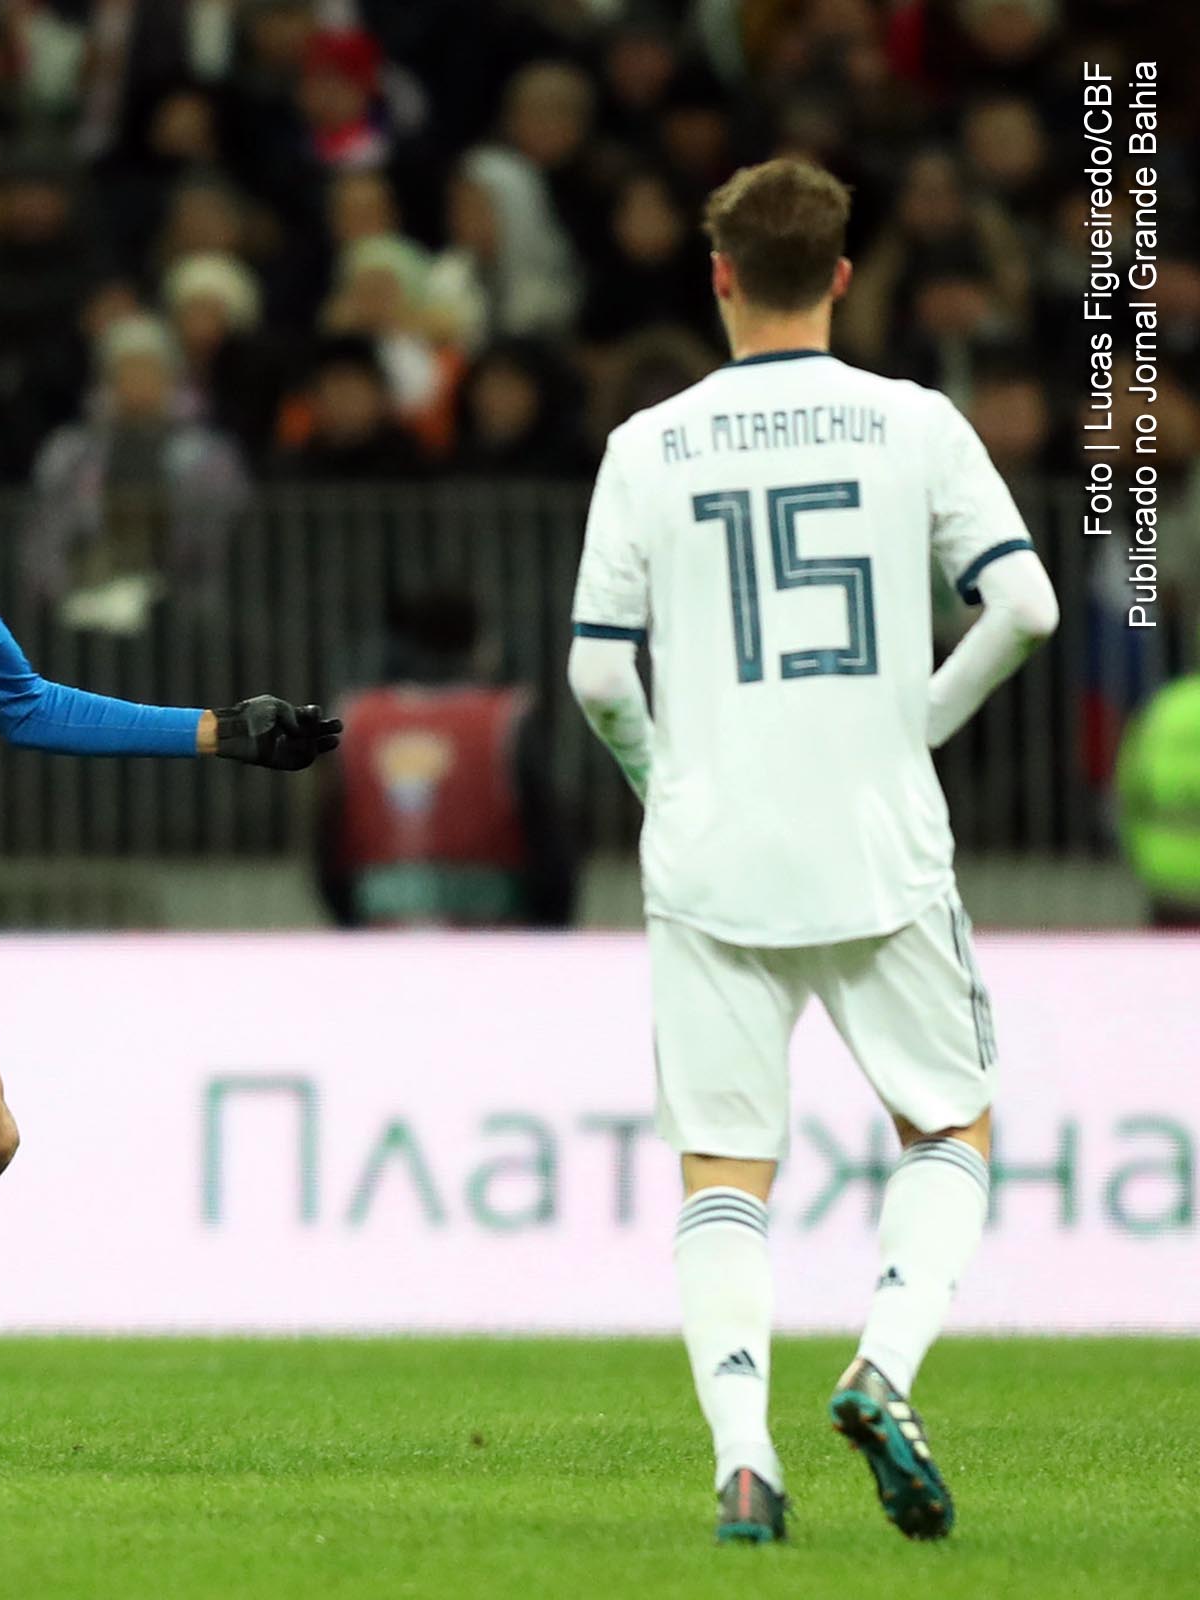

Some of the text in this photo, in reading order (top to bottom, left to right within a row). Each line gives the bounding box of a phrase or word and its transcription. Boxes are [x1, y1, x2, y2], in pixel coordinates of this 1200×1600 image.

[661, 405, 888, 464] AL. MIRANCHUK
[692, 480, 880, 684] 15
[203, 1074, 1198, 1231] Платжна
